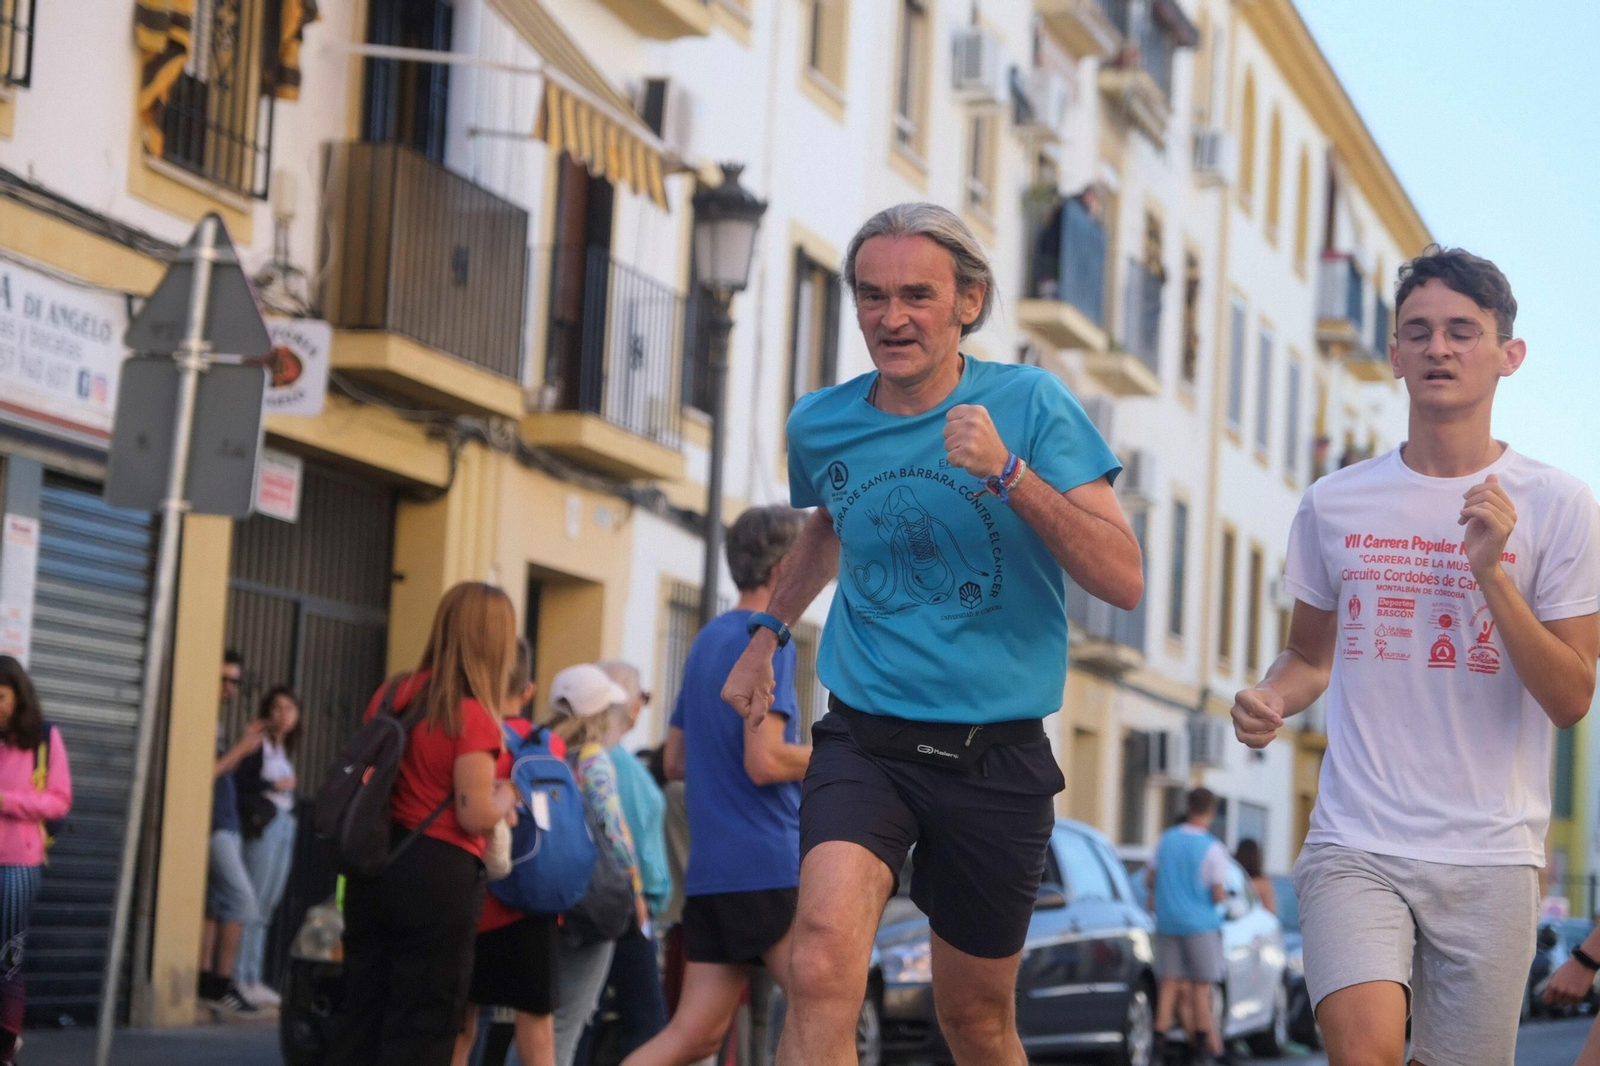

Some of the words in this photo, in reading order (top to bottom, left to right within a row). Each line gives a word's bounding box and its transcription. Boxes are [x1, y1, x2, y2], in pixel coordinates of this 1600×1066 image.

[47, 303, 113, 344] ANGELO
[861, 470, 897, 493] SANTA
[846, 489, 861, 506] DE
[958, 485, 995, 531] CONTRA
[989, 531, 1000, 546] EL
[1345, 533, 1361, 549] VII
[1363, 533, 1409, 550] Carrera
[1411, 535, 1458, 555] Popular
[989, 547, 1004, 598] CÁNCER
[1415, 557, 1430, 568] DE
[1432, 559, 1444, 569] LA
[1446, 559, 1472, 572] MÚS
[1341, 568, 1381, 581] Circuito
[1384, 568, 1440, 586] Cordobés
[1442, 574, 1456, 588] de
[1458, 576, 1482, 591] Car
[1422, 587, 1433, 595] DE
[1378, 598, 1415, 608] Deportes
